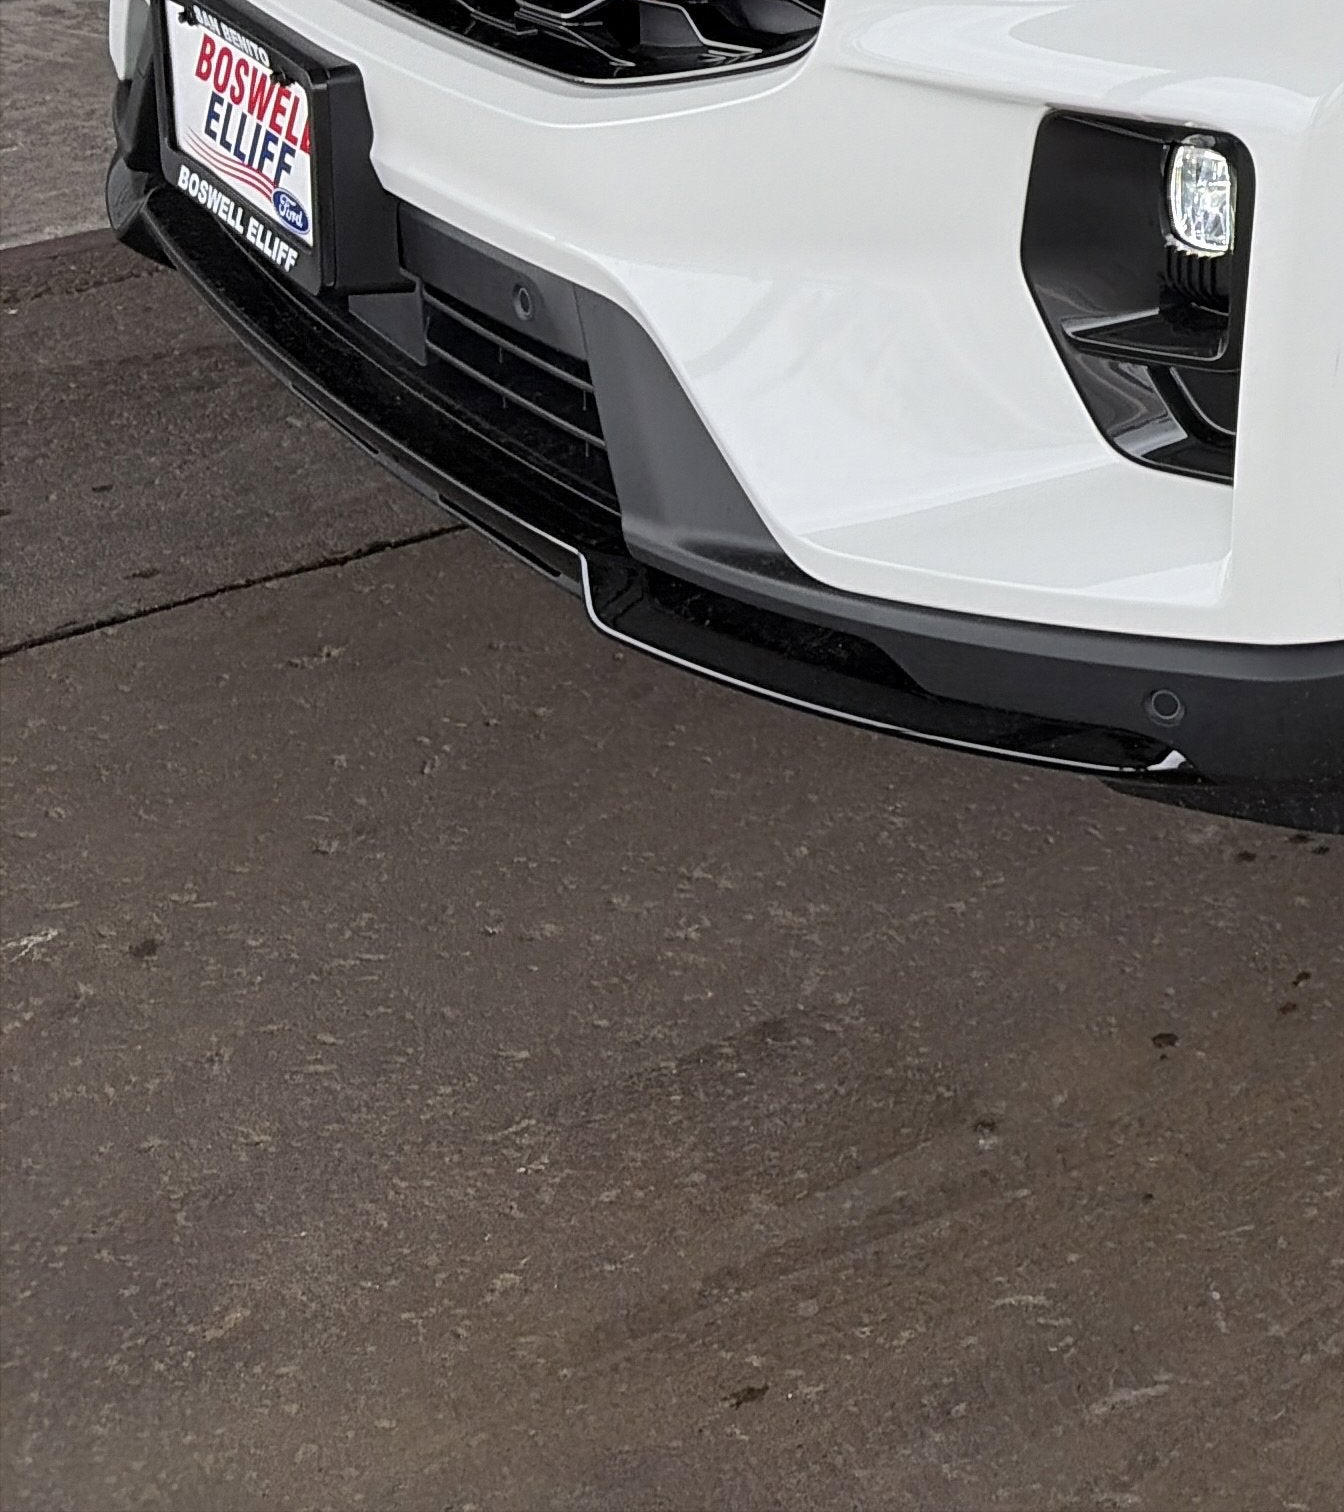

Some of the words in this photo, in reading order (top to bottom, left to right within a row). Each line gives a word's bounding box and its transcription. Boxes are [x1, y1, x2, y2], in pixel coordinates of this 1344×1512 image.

[194, 5, 219, 37] SAN
[222, 21, 270, 65] BENITO
[204, 92, 296, 187] ELLIFF
[177, 165, 245, 235] BOSWELL
[246, 217, 298, 273] ELLIFF
[278, 198, 303, 227] Ford
